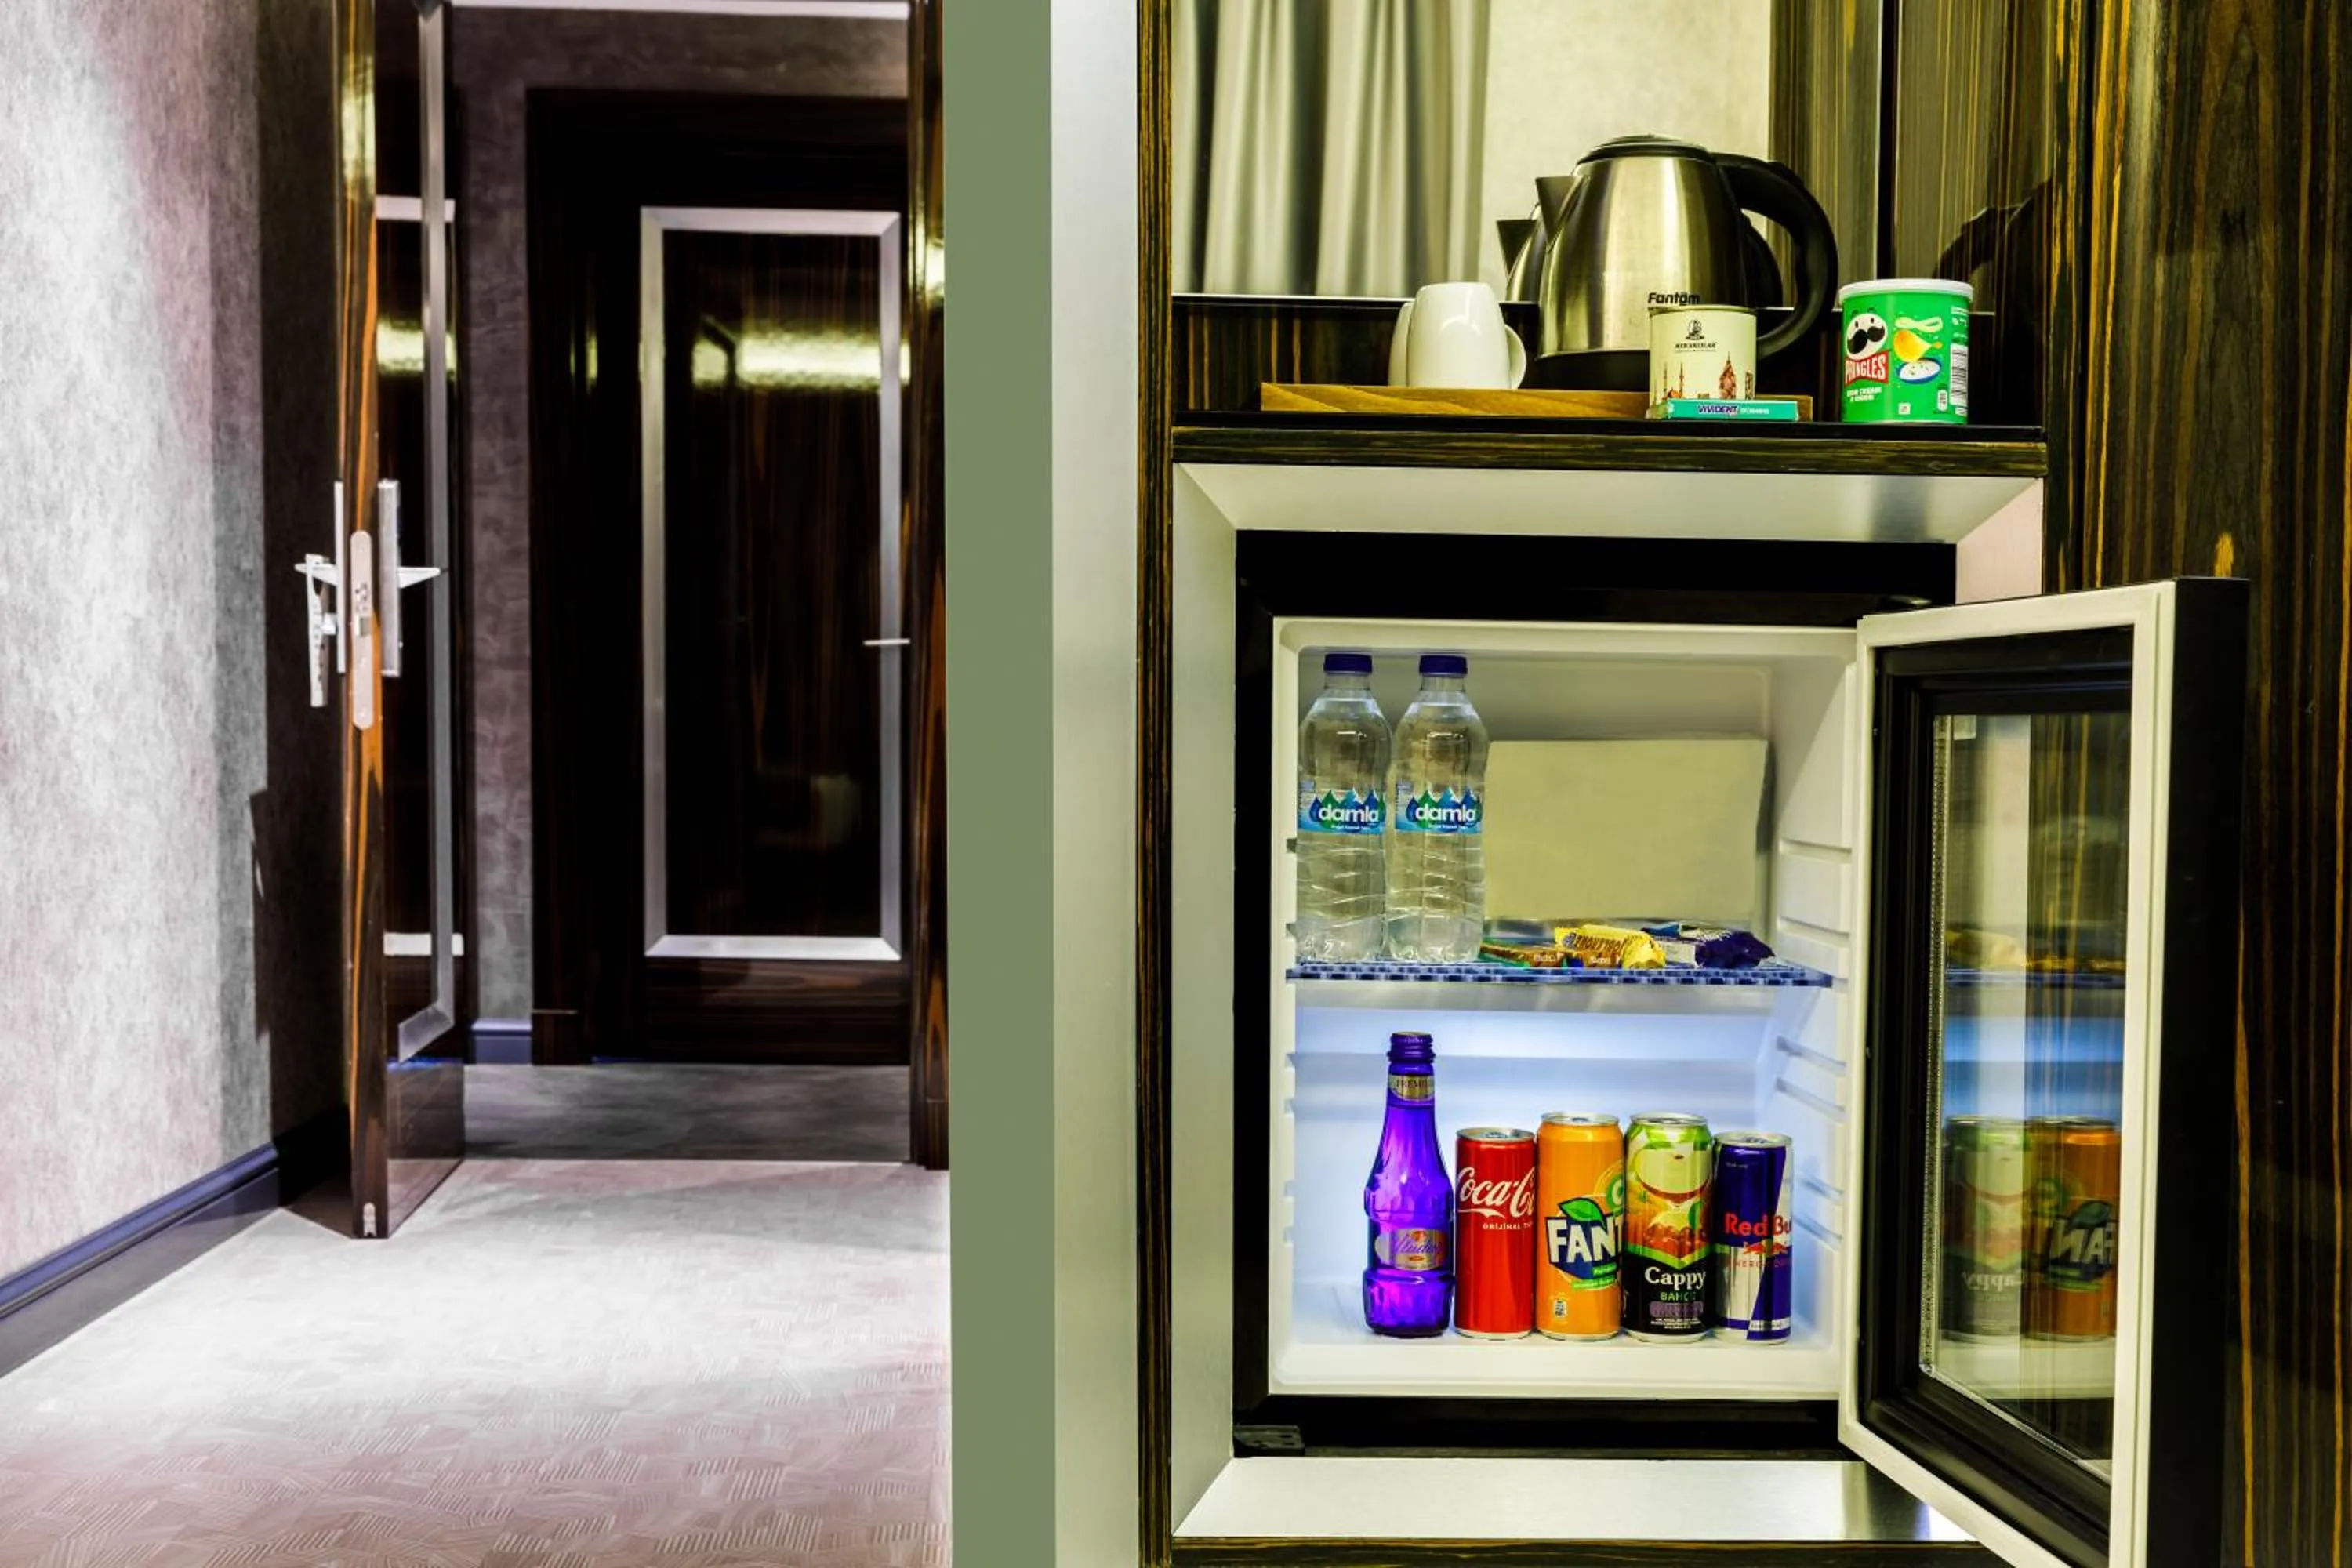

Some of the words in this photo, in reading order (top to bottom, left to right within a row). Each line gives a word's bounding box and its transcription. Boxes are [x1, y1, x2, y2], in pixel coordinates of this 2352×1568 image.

[1845, 354, 1886, 383] PRINGLES
[1318, 804, 1379, 822] damla
[1415, 804, 1475, 822] damla
[1457, 1167, 1534, 1218] Coca-Co
[1725, 1213, 1769, 1236] Red
[1773, 1216, 1792, 1236] Bu
[1547, 1217, 1623, 1263] FANT
[1645, 1266, 1706, 1290] Cappy
